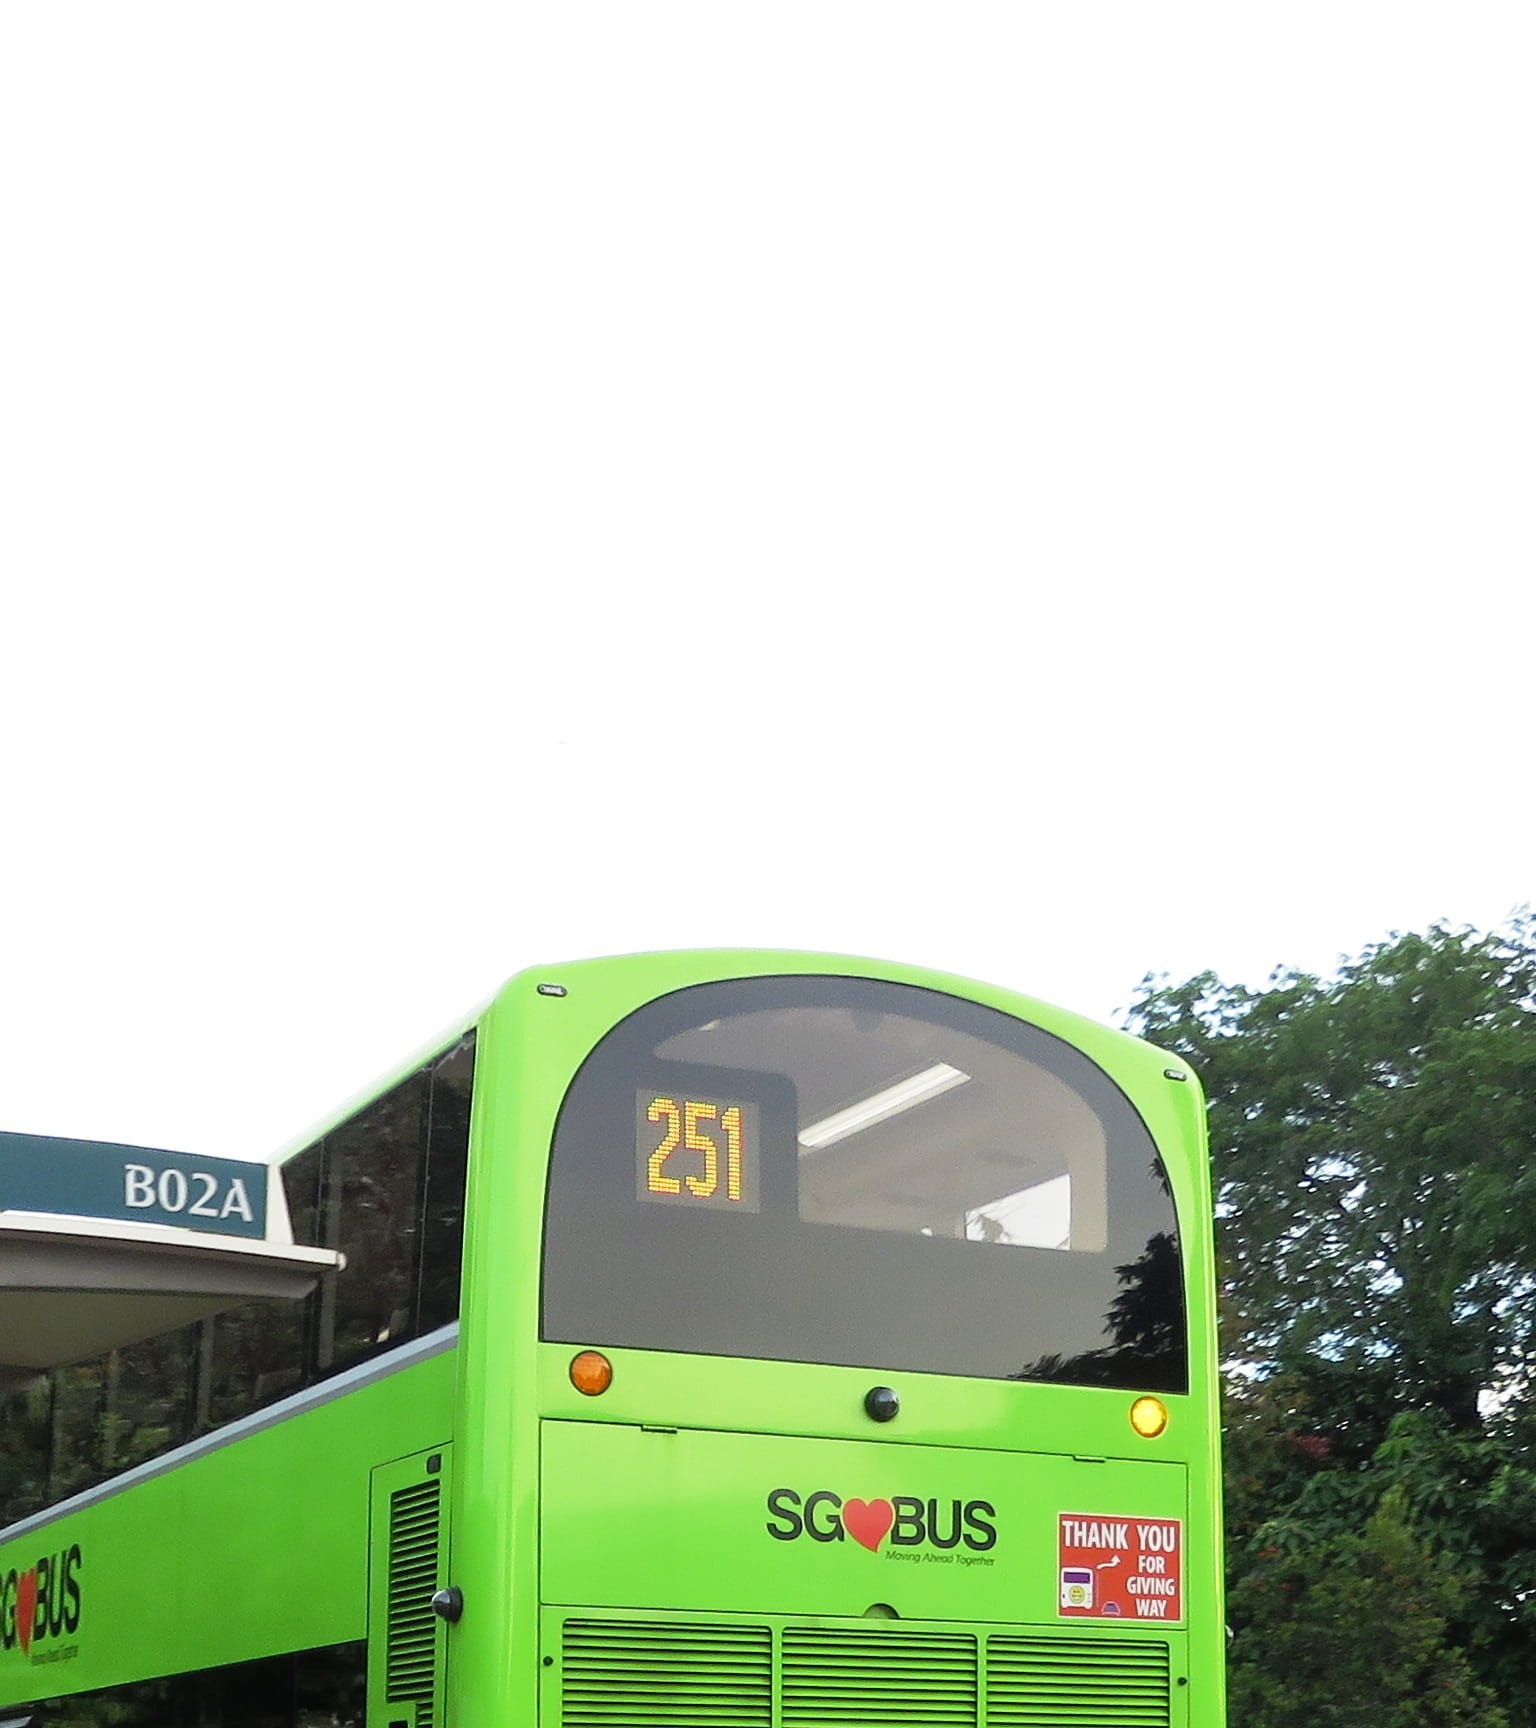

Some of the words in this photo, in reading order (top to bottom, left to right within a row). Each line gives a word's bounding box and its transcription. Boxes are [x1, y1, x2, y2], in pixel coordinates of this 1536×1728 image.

[647, 1098, 741, 1201] 251
[124, 1163, 254, 1222] B02A
[1062, 1520, 1129, 1550] THANK
[1136, 1524, 1175, 1553] YOU
[885, 1551, 921, 1564] Moving
[923, 1552, 954, 1564] Ahead
[955, 1554, 995, 1567] Together
[1138, 1555, 1165, 1574] FOR
[1126, 1576, 1175, 1596] GIVING
[1135, 1598, 1167, 1617] WAY
